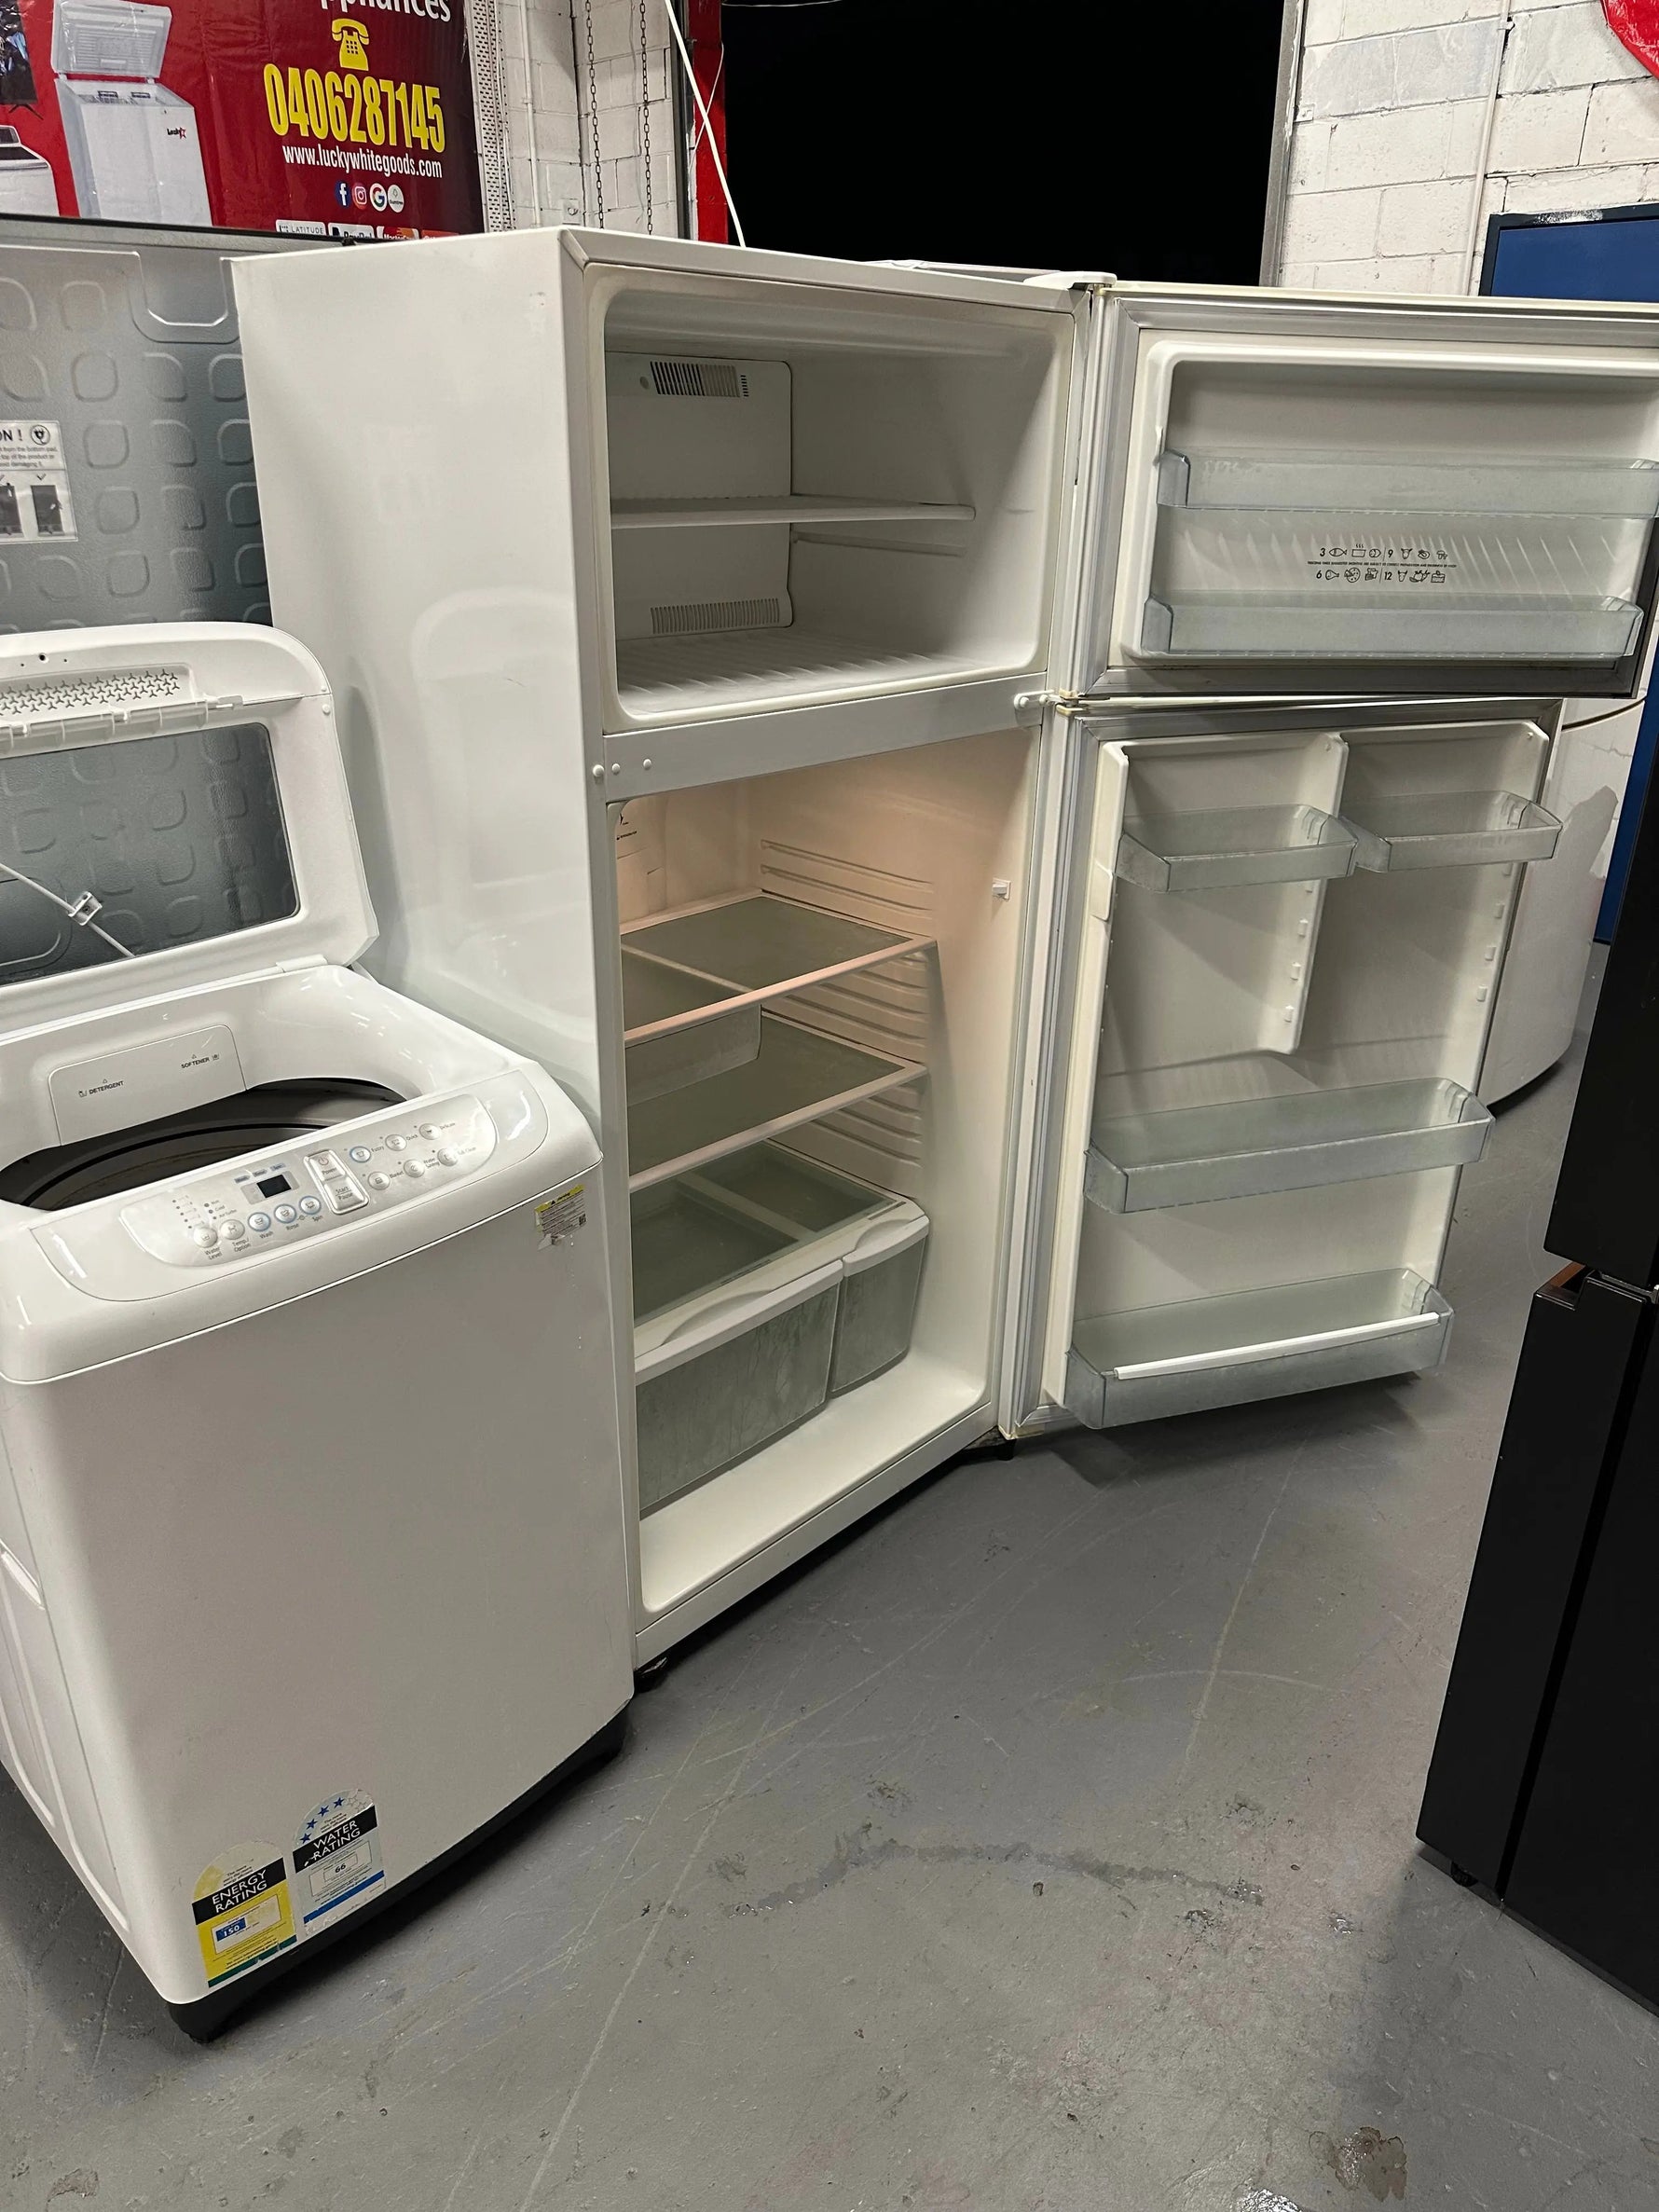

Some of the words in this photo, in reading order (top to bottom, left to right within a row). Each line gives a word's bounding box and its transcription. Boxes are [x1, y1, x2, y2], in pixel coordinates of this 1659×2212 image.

[264, 63, 446, 153] 0406287145
[282, 144, 443, 178] www.luckywhitegoods.com
[291, 226, 323, 234] LATITUDE
[181, 1056, 210, 1069] SOFTENER
[89, 1080, 124, 1094] DETERGENT
[313, 1820, 358, 1849] WATER
[313, 1828, 361, 1861] RATING
[212, 1869, 267, 1905] ENERGY
[215, 1880, 267, 1914] RATING
